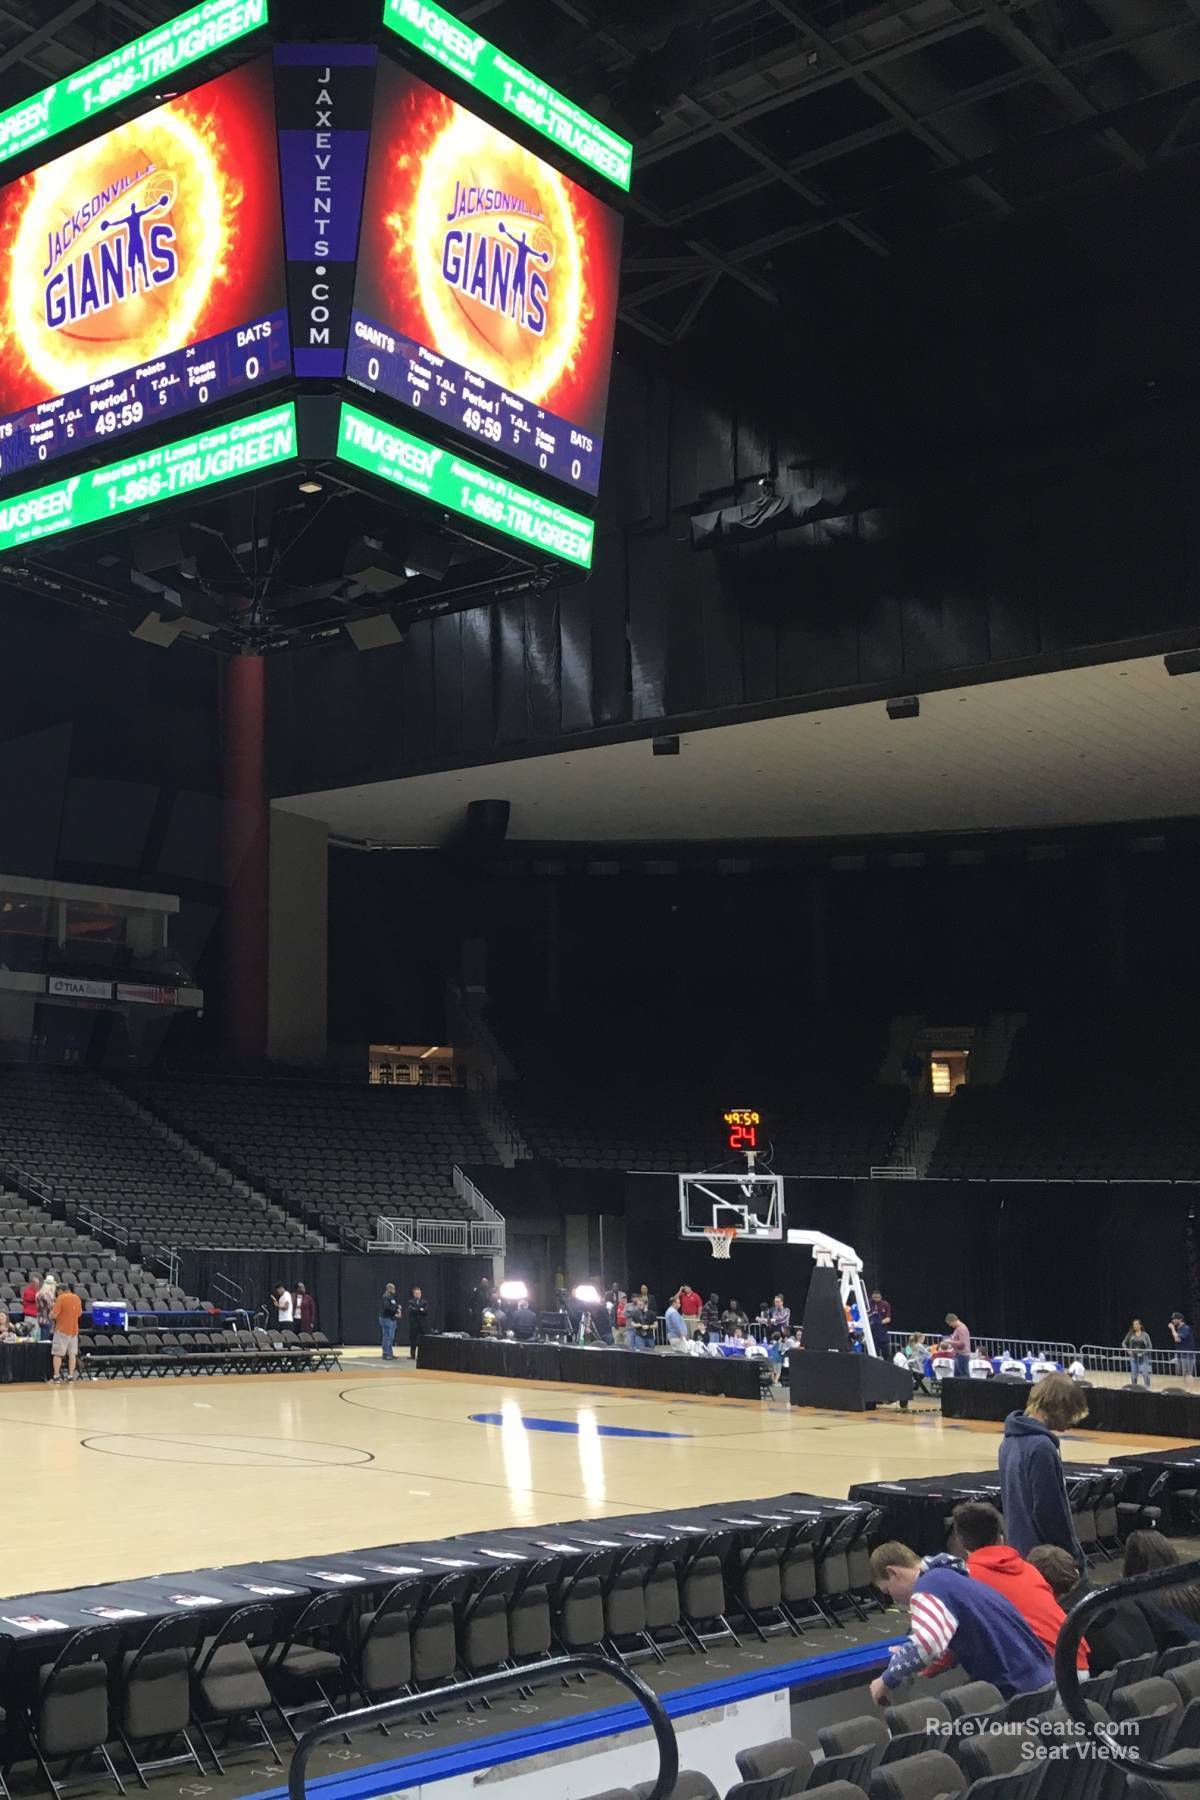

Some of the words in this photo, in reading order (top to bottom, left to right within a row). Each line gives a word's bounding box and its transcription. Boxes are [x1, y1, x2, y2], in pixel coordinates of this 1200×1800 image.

[83, 0, 264, 112] 1-866-TRUGREEN
[447, 181, 544, 221] JACKSONVILLE
[44, 164, 156, 276] JACKSONVILLE
[45, 218, 175, 329] GIANTS
[442, 230, 548, 336] GIANTS
[237, 321, 272, 347] BATS
[355, 321, 395, 353] GIANTS
[186, 348, 195, 358] 24
[136, 361, 166, 380] Points
[187, 360, 215, 377] Team
[246, 356, 259, 379] 0
[368, 357, 379, 380] 0
[90, 379, 114, 395] Fouls
[189, 370, 216, 387] Fouls
[90, 389, 128, 414] Period
[130, 384, 136, 398] 1
[159, 390, 167, 405] 5
[198, 386, 208, 403] 0
[413, 390, 421, 406] 0
[440, 391, 447, 406] 5
[462, 387, 493, 413] Period
[37, 398, 65, 415] Player
[30, 419, 54, 433] Team
[95, 401, 144, 435] 49:59
[463, 407, 502, 441] 49:59
[30, 430, 54, 445] Fouls
[67, 424, 75, 438] 5
[165, 443, 198, 463] Lawn
[200, 433, 228, 449] Care
[230, 410, 291, 441] Company
[513, 429, 520, 443] 5
[570, 430, 593, 452] BATS
[39, 445, 47, 460] 0
[344, 415, 441, 479] TRUGREEN
[107, 427, 292, 510] 1-866-TRUGREEN
[540, 453, 547, 469] 0
[571, 459, 581, 479] 0
[461, 486, 591, 561] 1-866-TRUGREEN
[65, 983, 84, 993] TIAA
[724, 1112, 760, 1125] 49:59
[730, 1126, 756, 1148] 24
